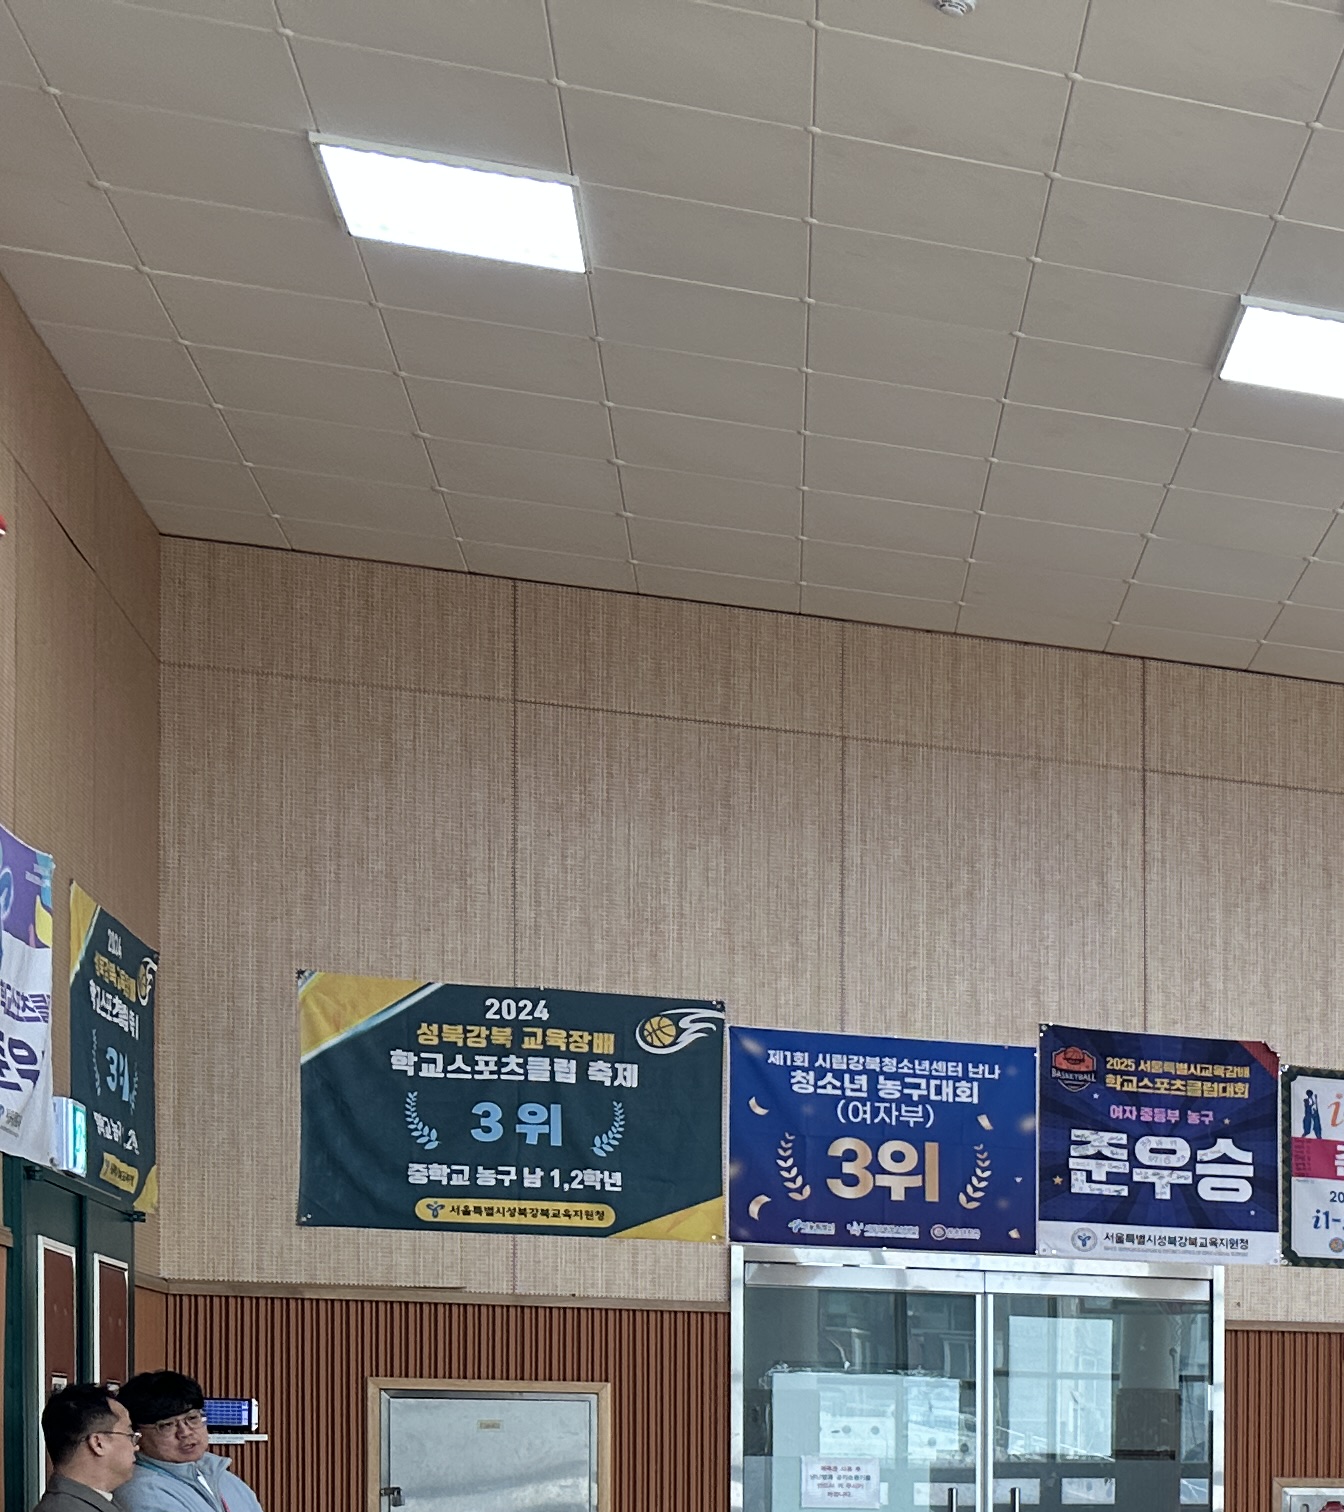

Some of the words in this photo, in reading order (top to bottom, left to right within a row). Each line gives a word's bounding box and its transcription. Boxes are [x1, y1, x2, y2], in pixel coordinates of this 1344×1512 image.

[485, 998, 549, 1022] 2024
[416, 1022, 513, 1047] 성북강북
[521, 1025, 616, 1054] 교육장배
[390, 1048, 577, 1084] 학교스포츠클럽
[587, 1058, 639, 1088] 축제
[767, 1049, 809, 1067] 제1회
[814, 1053, 963, 1077] 시립강북청소년센터
[967, 1062, 1001, 1080] 난나
[1051, 1068, 1097, 1083] BASKETBALL
[1106, 1056, 1136, 1072] 2025
[790, 1069, 868, 1098] 청소년
[877, 1075, 979, 1104] 농구대회
[1105, 1073, 1250, 1099] 학교스포츠클럽대회
[836, 1099, 935, 1128] (여자부)
[1109, 1104, 1137, 1121] 여자
[1187, 1110, 1214, 1125] 농구
[407, 1163, 470, 1187] 중학교
[476, 1165, 517, 1187] 농구
[523, 1167, 544, 1188] 남
[550, 1168, 623, 1192] 1,2학년
[826, 1137, 940, 1203] 3위
[1068, 1128, 1254, 1203] 준우승
[1103, 1231, 1250, 1250] 서울특별시성북강북교육지원청
